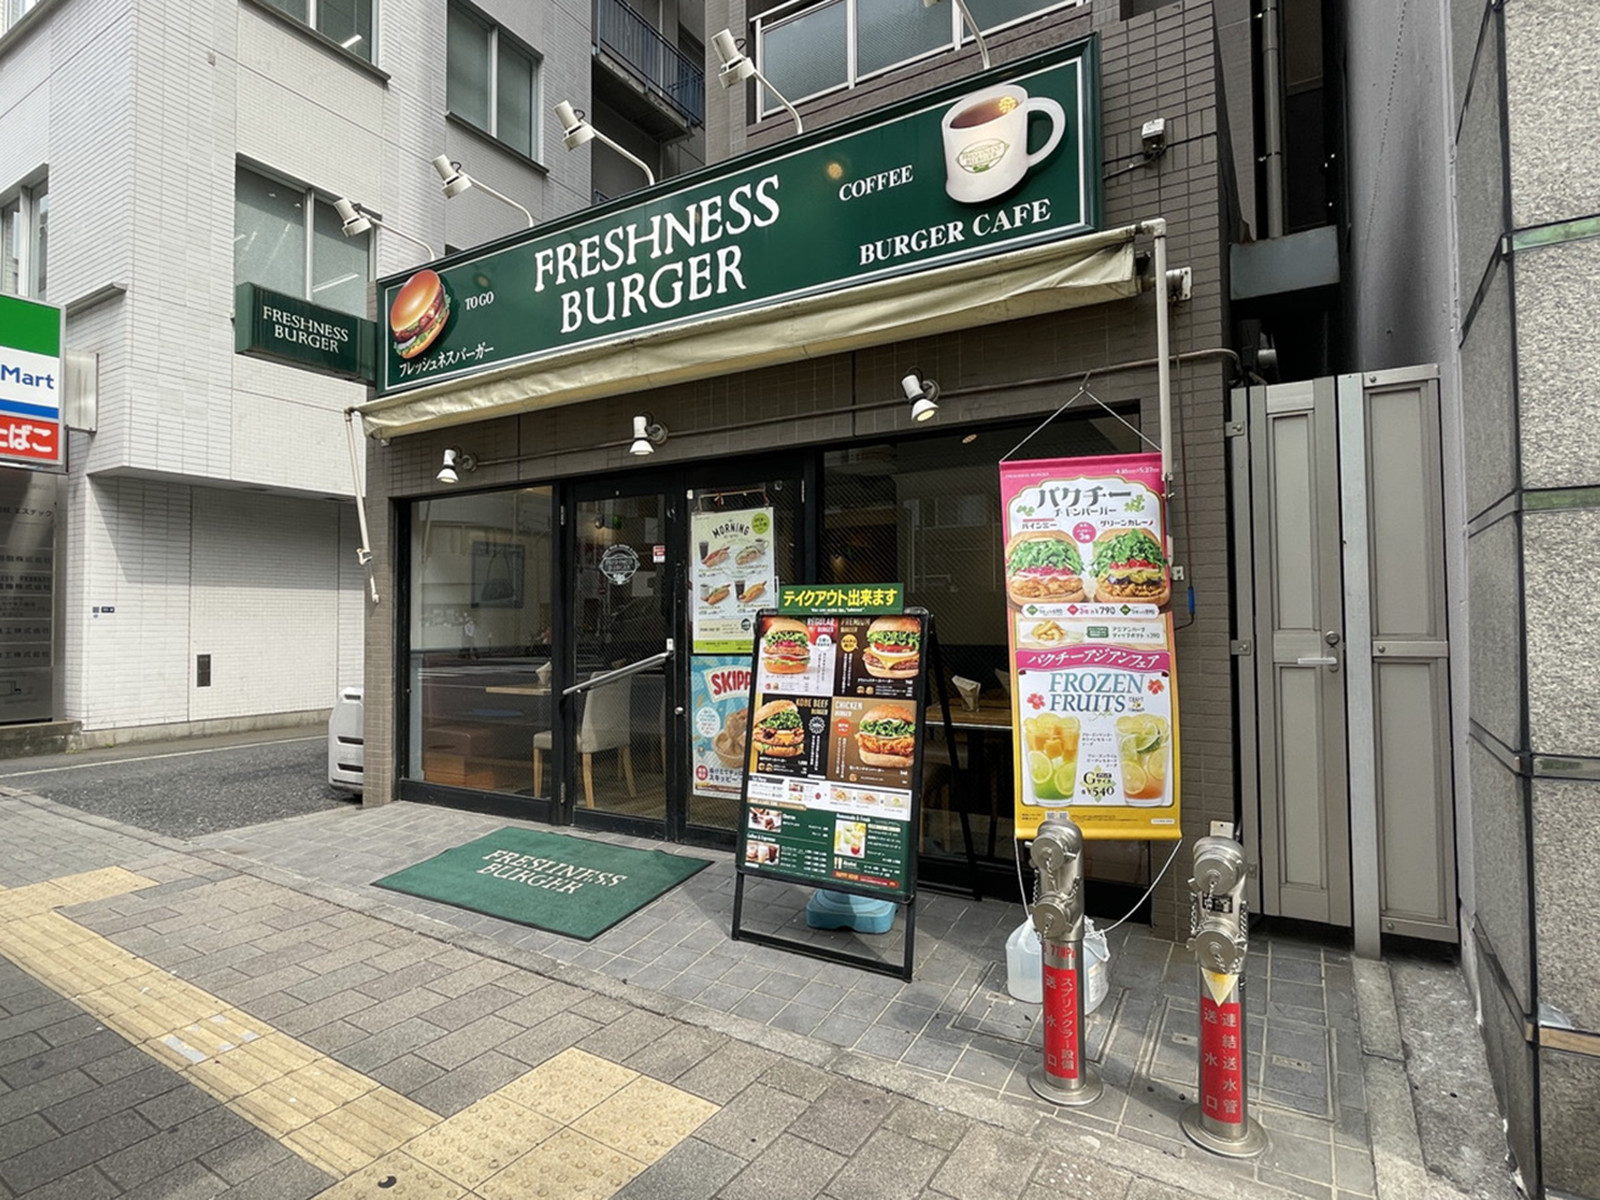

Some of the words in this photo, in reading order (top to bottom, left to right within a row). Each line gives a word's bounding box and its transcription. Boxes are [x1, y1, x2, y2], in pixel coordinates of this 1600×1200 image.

[838, 164, 913, 201] COFFEE
[533, 174, 780, 292] FRESHNESS
[860, 219, 965, 266] BURGER
[972, 198, 1052, 237] CAFE
[464, 297, 478, 311] TO
[478, 292, 494, 308] GO
[560, 246, 747, 334] BURGER
[262, 305, 349, 344] FRESHNESS
[274, 324, 340, 354] BURGER
[399, 344, 494, 377] フレッシュネスバーガー
[1, 363, 54, 390] Mart
[1037, 486, 1132, 508] パクチー
[712, 523, 750, 538] MORNING
[1100, 519, 1150, 528] グリーンカレー
[783, 588, 898, 607] テイクアウト出来ます
[1027, 648, 1160, 669] パクチーアジアンフェア
[1049, 672, 1145, 694] FROZEN
[835, 701, 863, 710] CHICKEN
[1049, 693, 1126, 713] FRUITS
[1083, 771, 1095, 785] G
[476, 863, 583, 894] BURGER
[481, 849, 628, 887] FRESHNESS
[1046, 973, 1057, 1067] 送水口
[1061, 977, 1076, 1070] スプリンクラー設備
[1203, 1007, 1218, 1112] 送水口
[1221, 1012, 1238, 1115] 連結送水管
